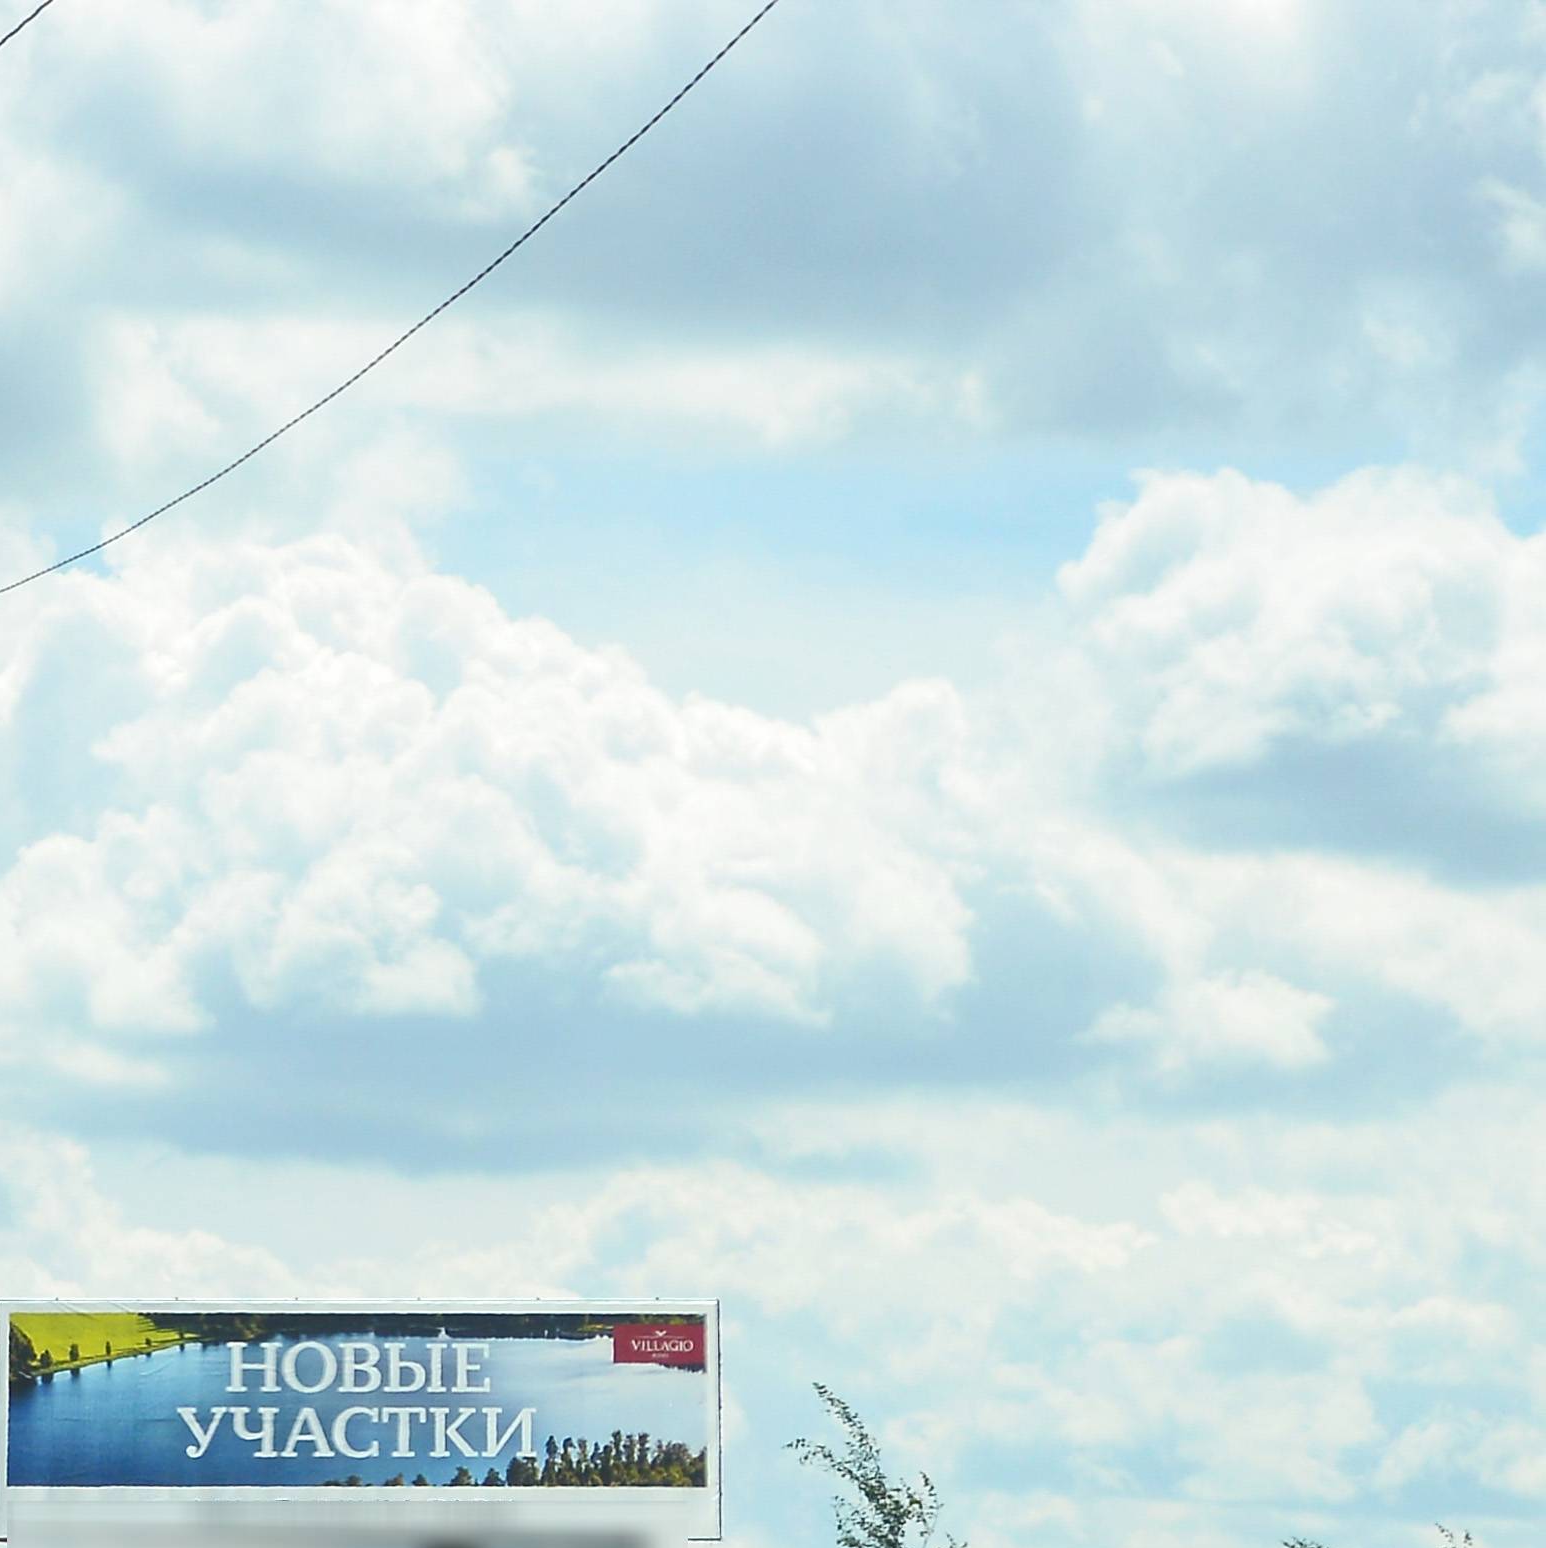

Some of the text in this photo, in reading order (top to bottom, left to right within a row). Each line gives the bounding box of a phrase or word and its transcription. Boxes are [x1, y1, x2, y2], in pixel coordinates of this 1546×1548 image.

[225, 1341, 490, 1394] НОВЫЕ
[631, 1339, 694, 1352] VILLAGIO
[176, 1406, 538, 1458] УЧАСТКИ
